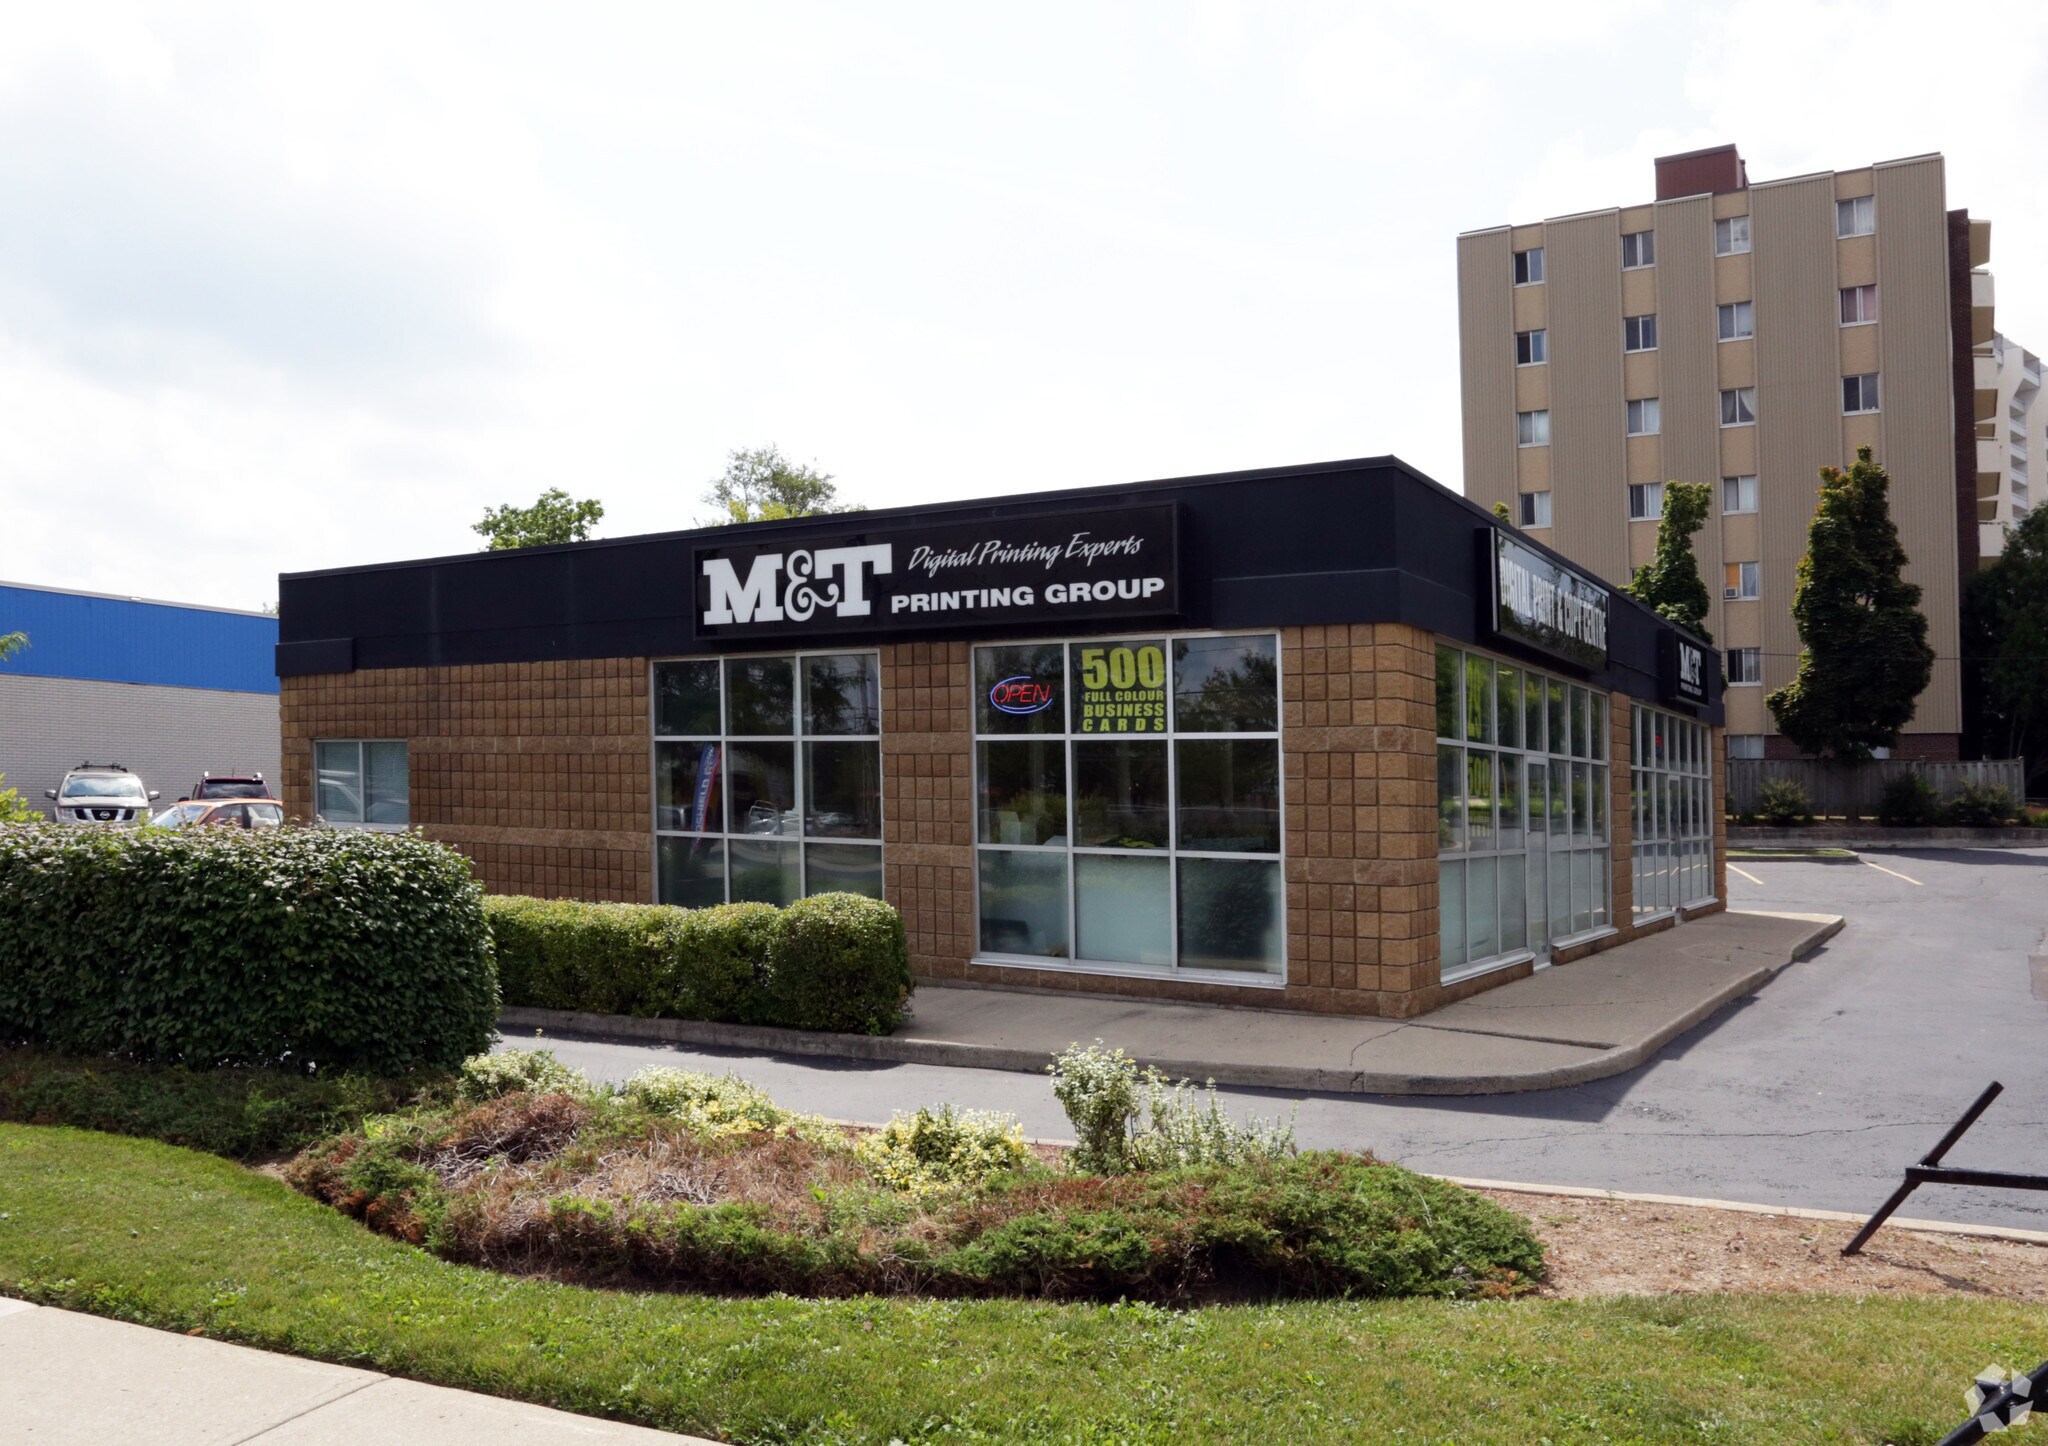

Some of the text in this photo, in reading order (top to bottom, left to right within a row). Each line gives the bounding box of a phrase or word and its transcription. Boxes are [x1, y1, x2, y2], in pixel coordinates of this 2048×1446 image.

[908, 532, 1144, 578] Digital Printing Experts
[703, 543, 892, 625] M&T
[891, 577, 1165, 613] PRINTING GROUP
[1499, 556, 1532, 618] DIGITAL
[1533, 574, 1555, 630] PRINT
[1081, 646, 1165, 690] 500
[993, 684, 1050, 703] OPEN
[1084, 703, 1164, 717] BUSINESS
[1085, 691, 1164, 702] FULL COLOUR
[1083, 718, 1164, 732] CARDS
